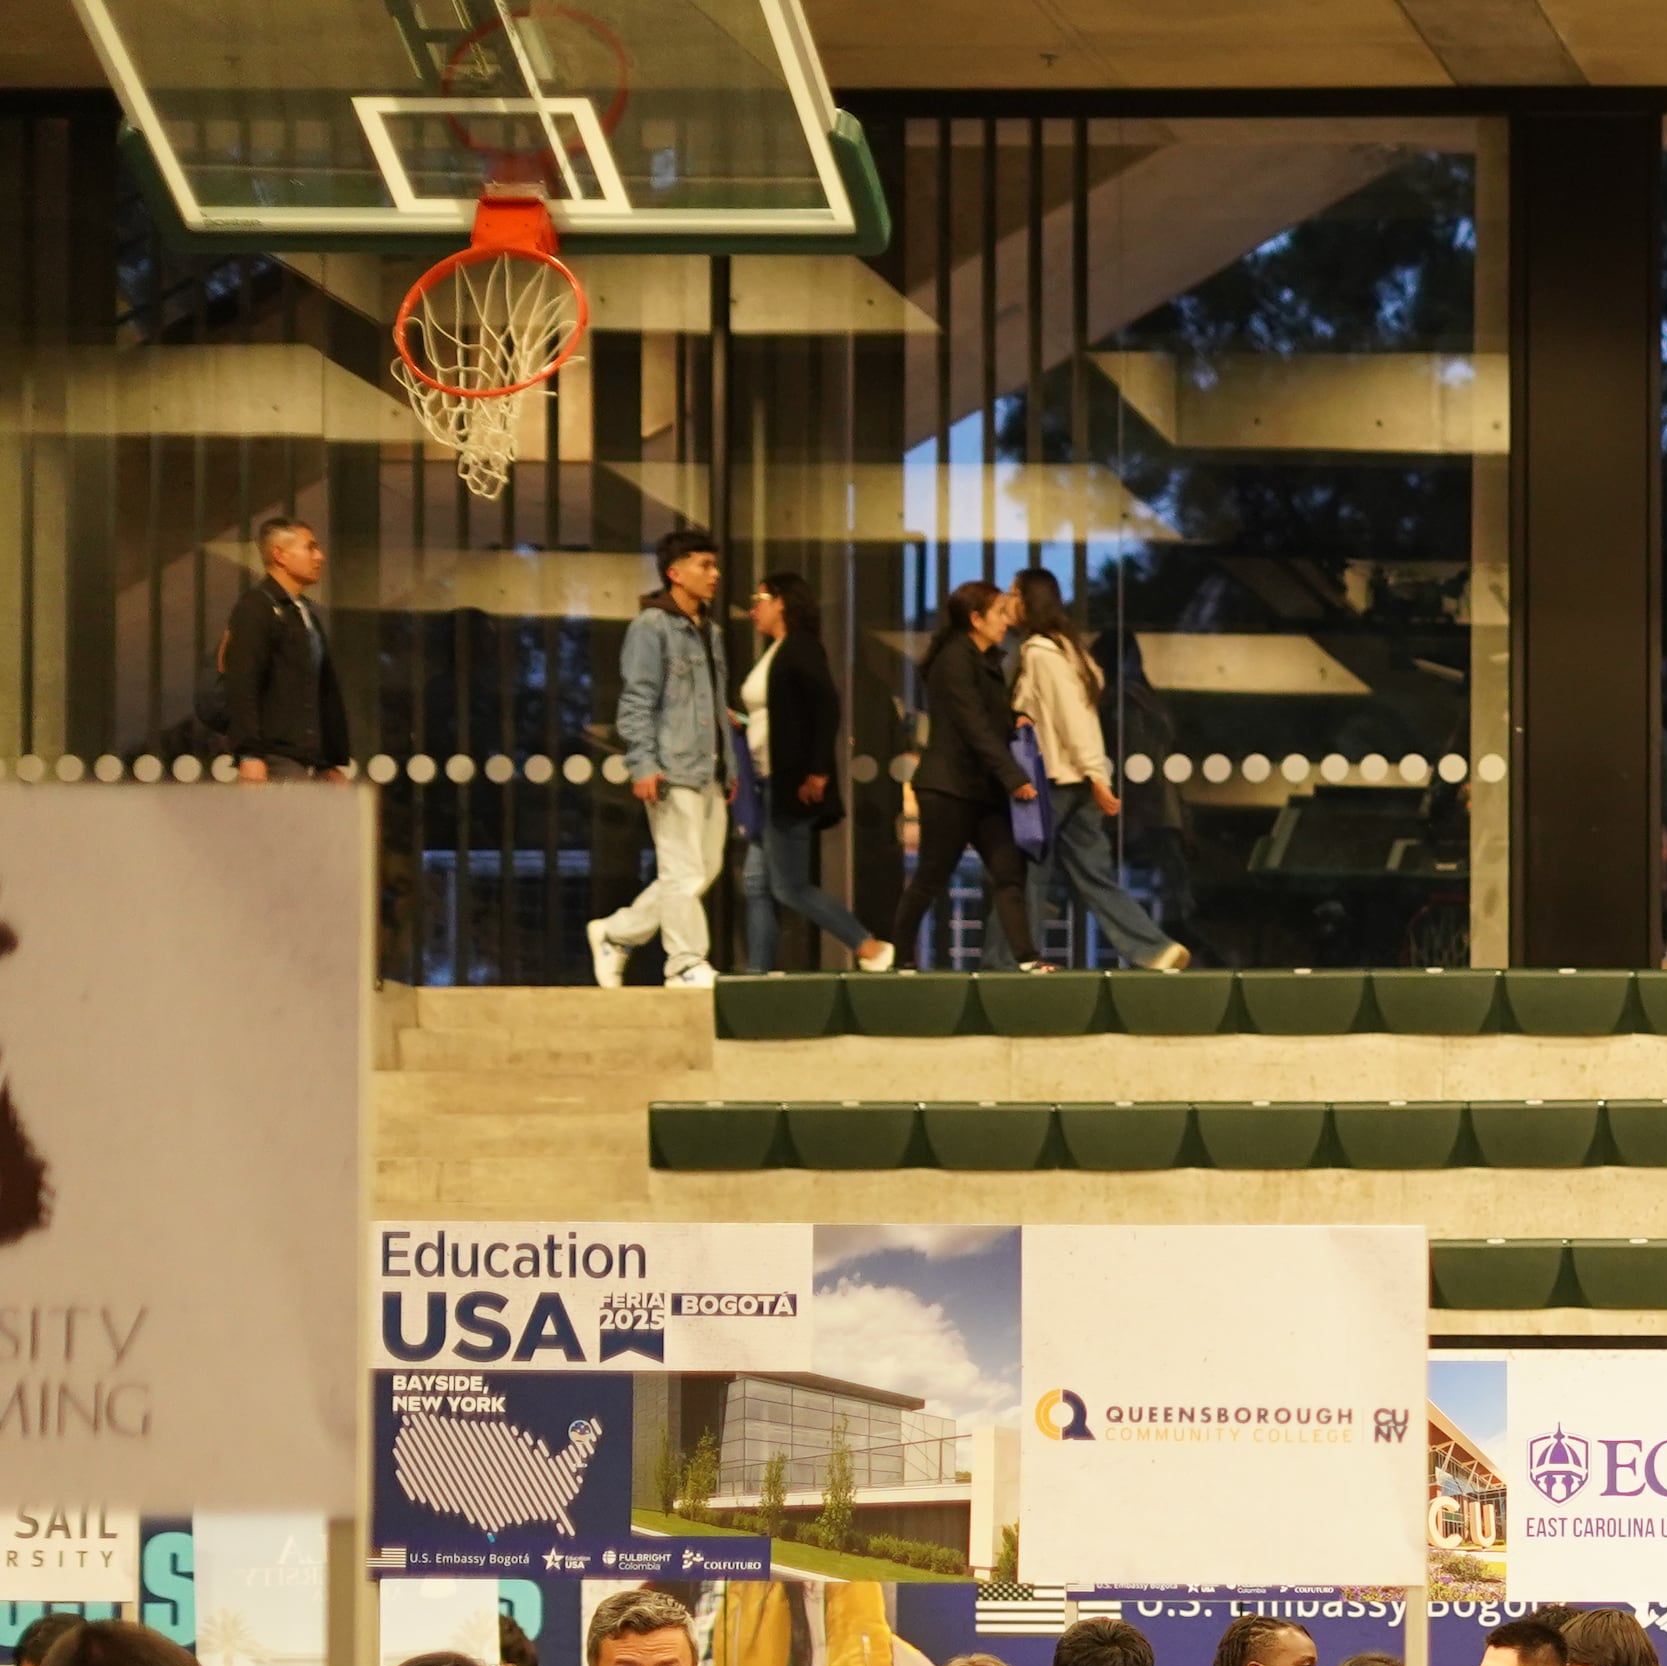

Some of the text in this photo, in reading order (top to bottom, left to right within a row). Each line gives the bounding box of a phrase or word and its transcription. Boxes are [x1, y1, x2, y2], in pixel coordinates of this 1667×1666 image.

[381, 1230, 647, 1279] Education
[600, 1292, 665, 1310] FERIA
[681, 1291, 794, 1316] BOGOTÁ
[382, 1291, 588, 1363] USA
[600, 1309, 665, 1331] 2025
[392, 1376, 489, 1395] BAYSIDE,
[392, 1396, 506, 1413] NEW YORK
[1106, 1405, 1354, 1425] QUEENSBOROUGH
[1373, 1407, 1409, 1427] CU
[1105, 1426, 1352, 1444] COMMUNITY COLLEGE
[1374, 1426, 1408, 1443] NY
[1526, 1517, 1568, 1537] EAST
[1573, 1518, 1654, 1538] CAROLINA
[410, 1552, 530, 1567] U.S. Embassy Bogotá
[565, 1561, 585, 1570] USA
[619, 1553, 671, 1563] FULBRIGHT
[619, 1562, 661, 1571] Colombia
[704, 1561, 762, 1570] COLFUTURO
[1230, 1600, 1408, 1627] Embassy
